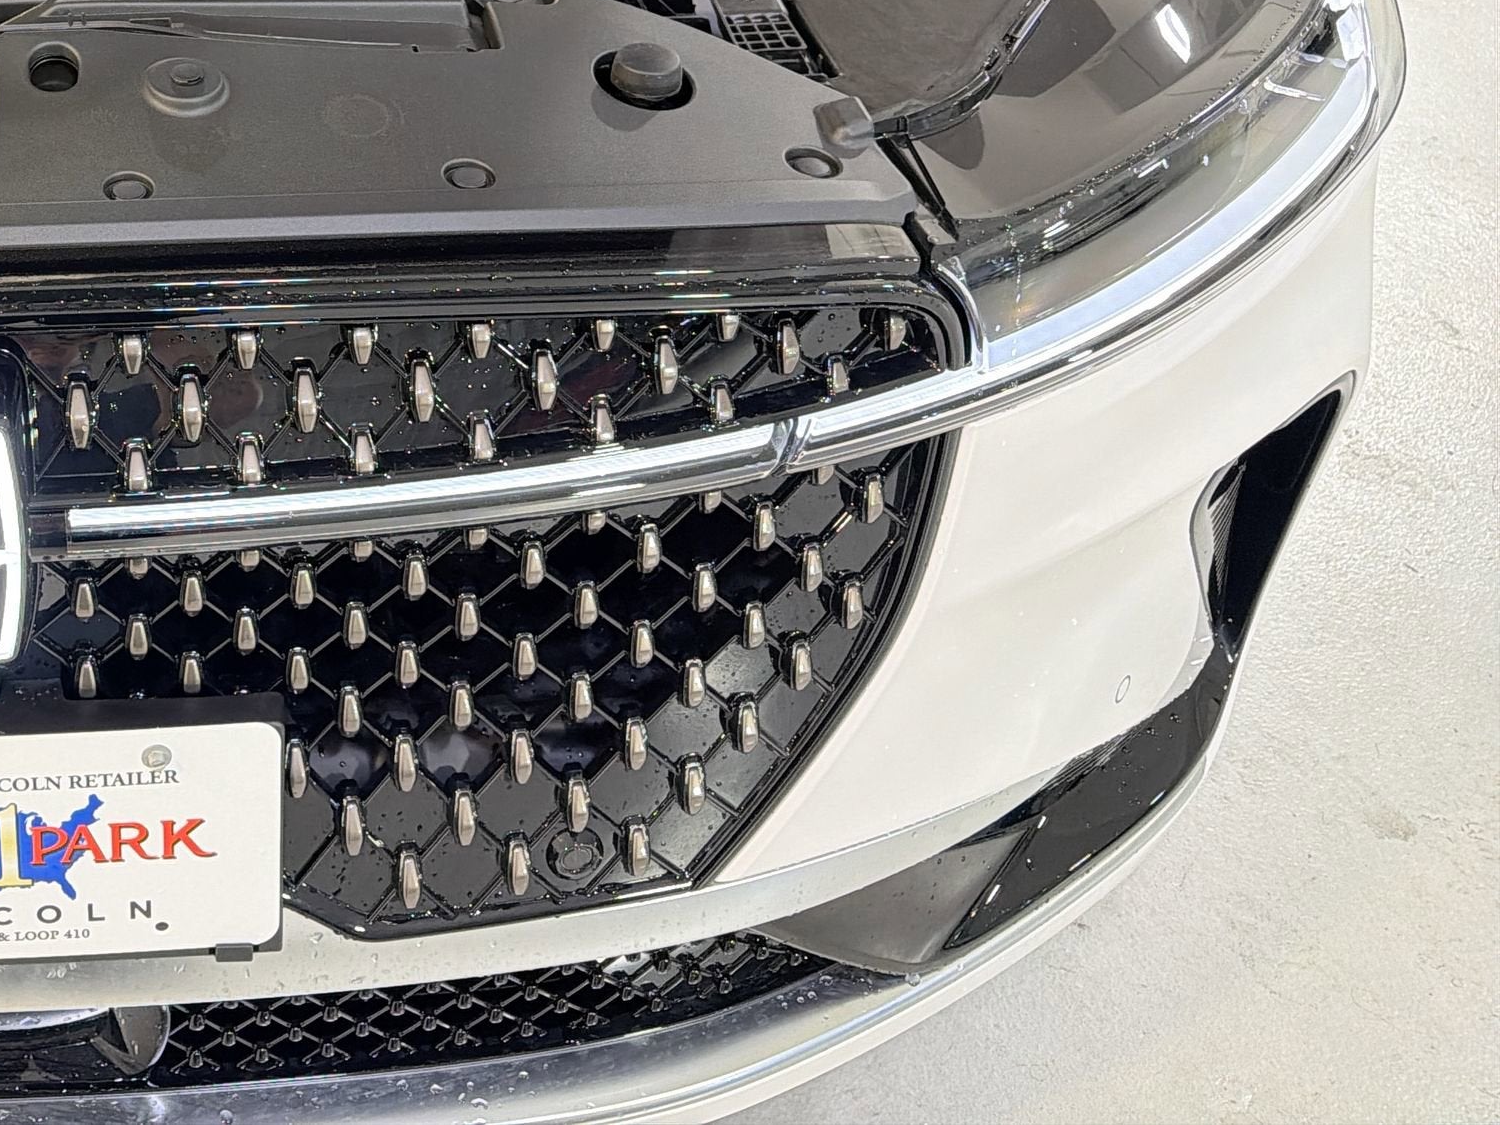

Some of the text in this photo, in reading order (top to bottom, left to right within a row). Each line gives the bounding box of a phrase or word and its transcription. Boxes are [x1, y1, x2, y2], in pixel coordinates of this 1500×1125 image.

[69, 770, 180, 789] RETAILER
[30, 818, 217, 867] PARK
[14, 930, 59, 942] LOOP
[64, 928, 90, 940] 410
